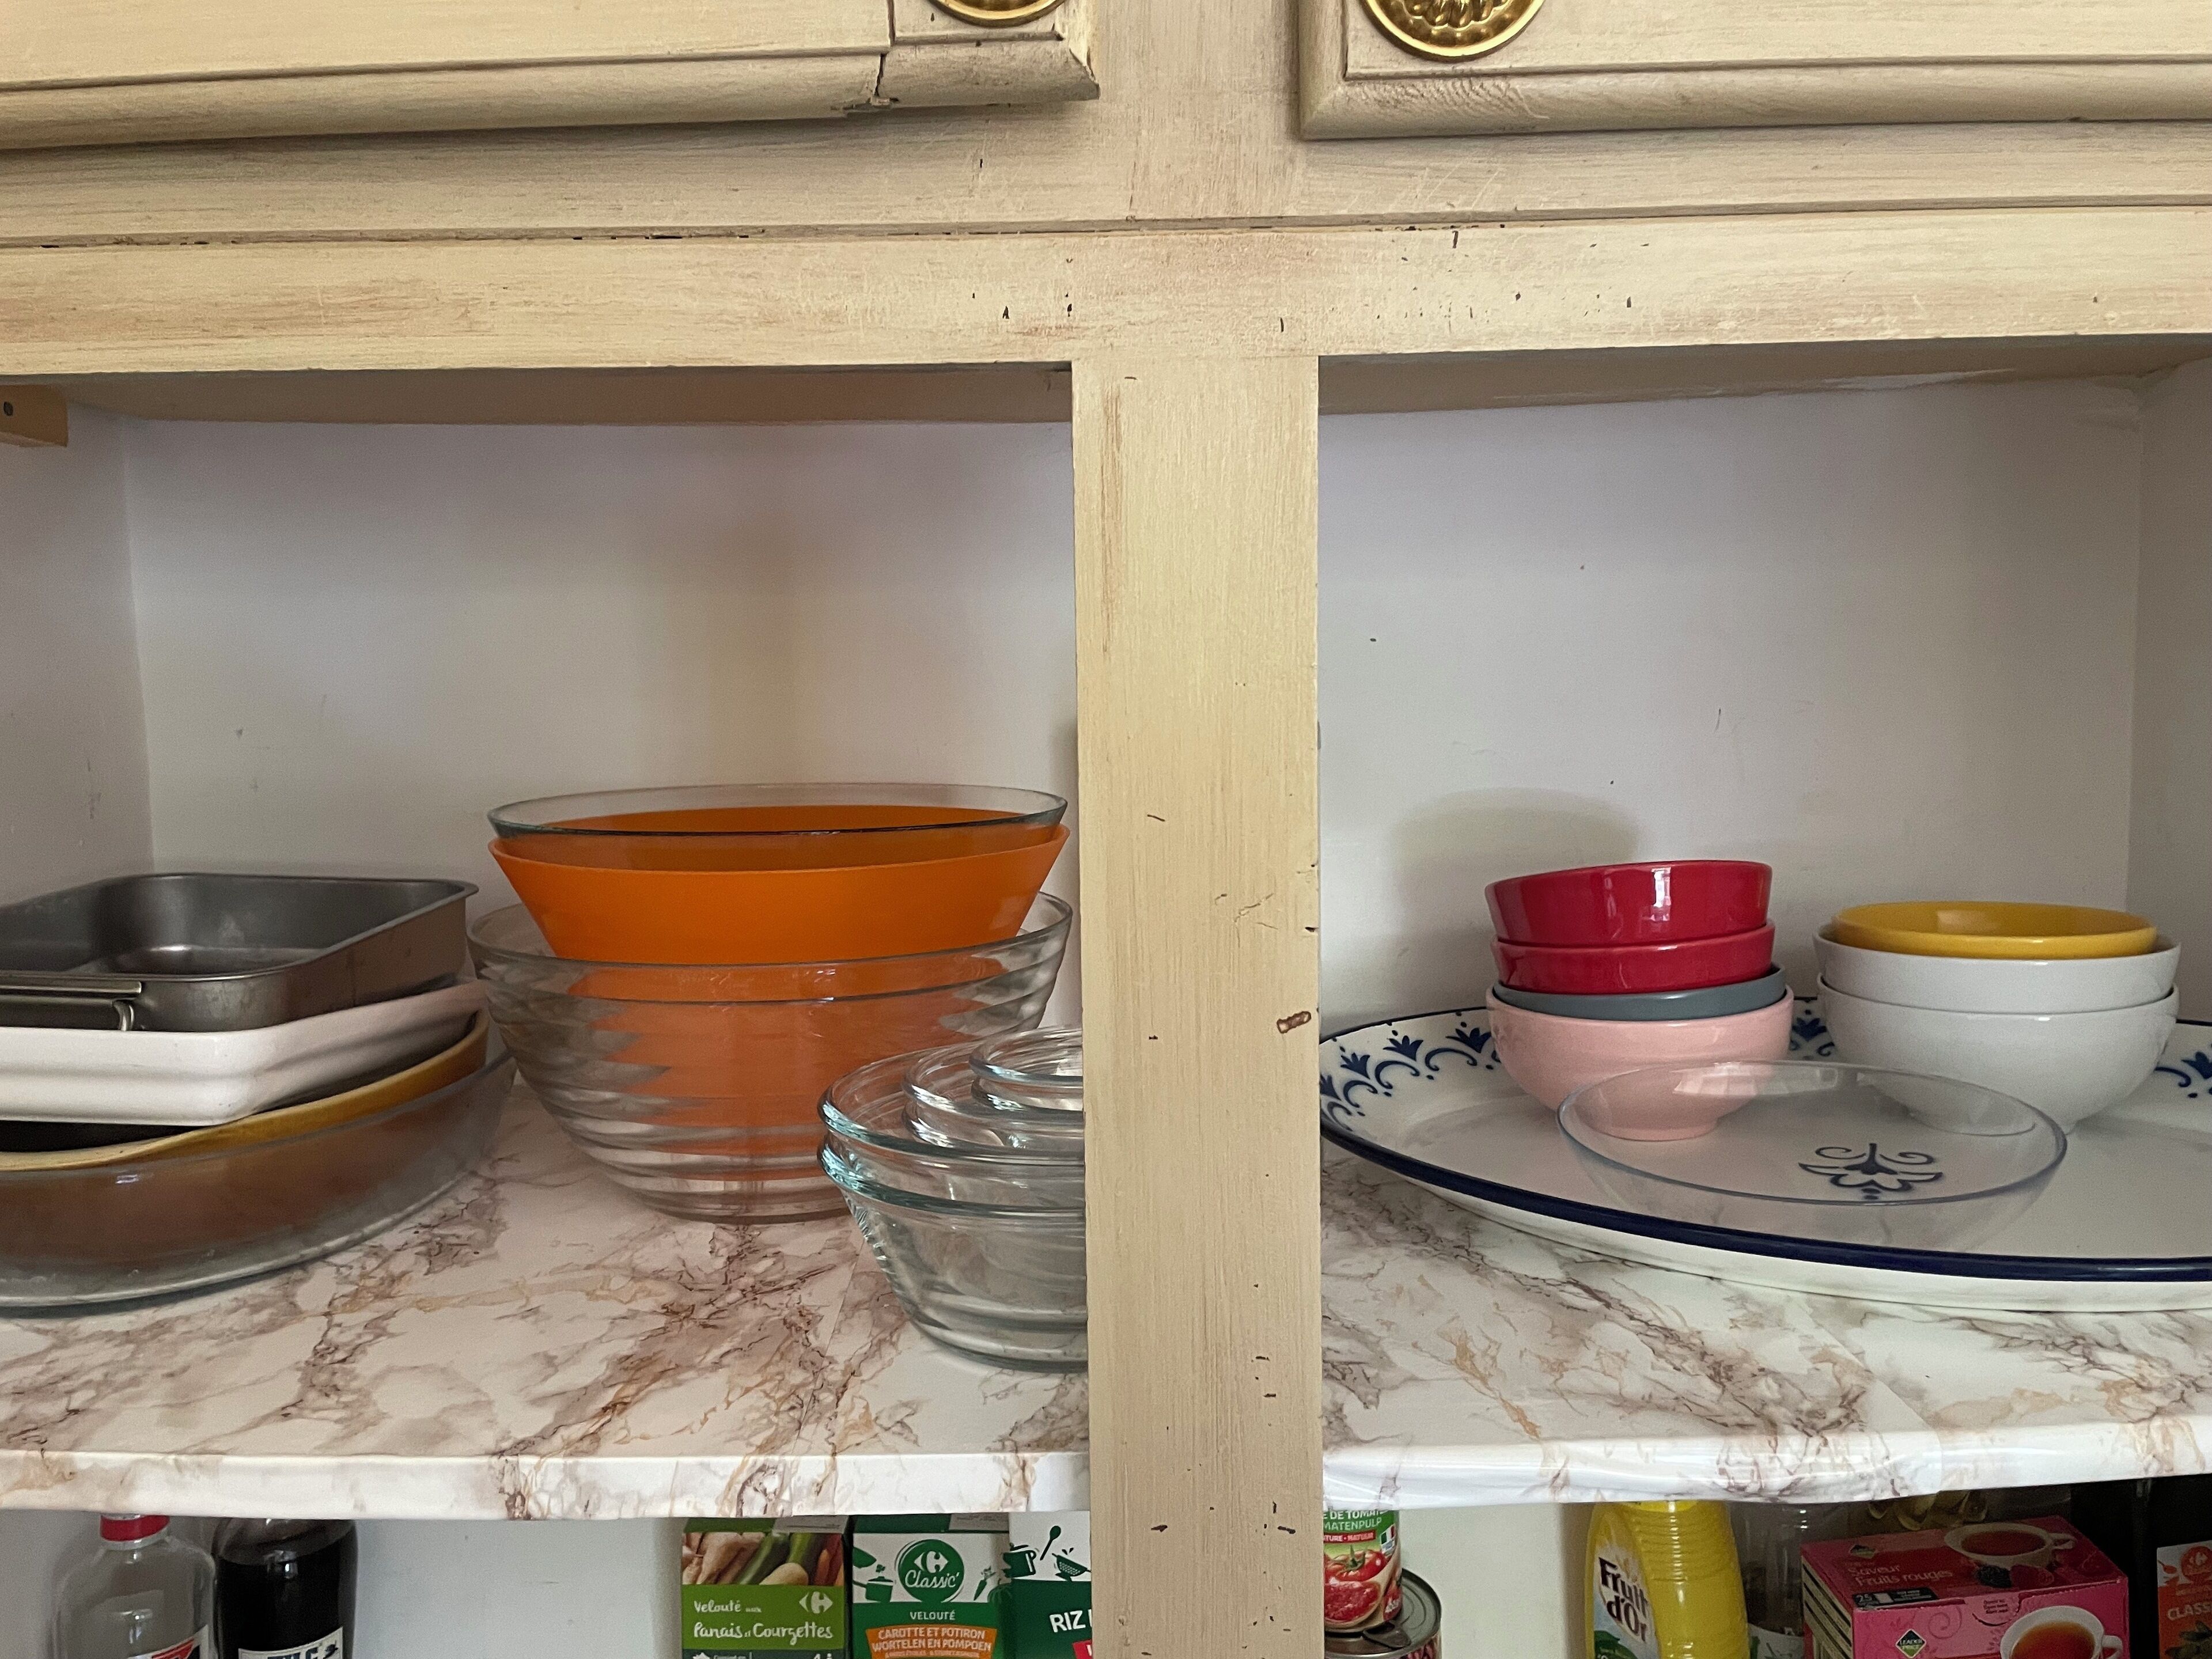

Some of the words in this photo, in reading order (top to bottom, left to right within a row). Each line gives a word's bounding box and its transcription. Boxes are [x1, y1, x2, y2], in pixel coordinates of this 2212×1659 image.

[1330, 1510, 1344, 1520] DE
[1903, 1570, 1953, 1582] rouges
[694, 1599, 741, 1613] Velouté
[910, 1609, 956, 1621] VELOUTÉ
[1049, 1610, 1086, 1633] RIZ
[694, 1622, 743, 1638] Panais
[752, 1621, 834, 1646] Courgettes
[878, 1627, 924, 1640] CAROTTE
[926, 1627, 940, 1638] ET
[941, 1627, 986, 1639] POTIRON
[872, 1638, 926, 1653] WORTELEN
[927, 1638, 941, 1650] EN
[942, 1639, 991, 1652] POMPOEN
